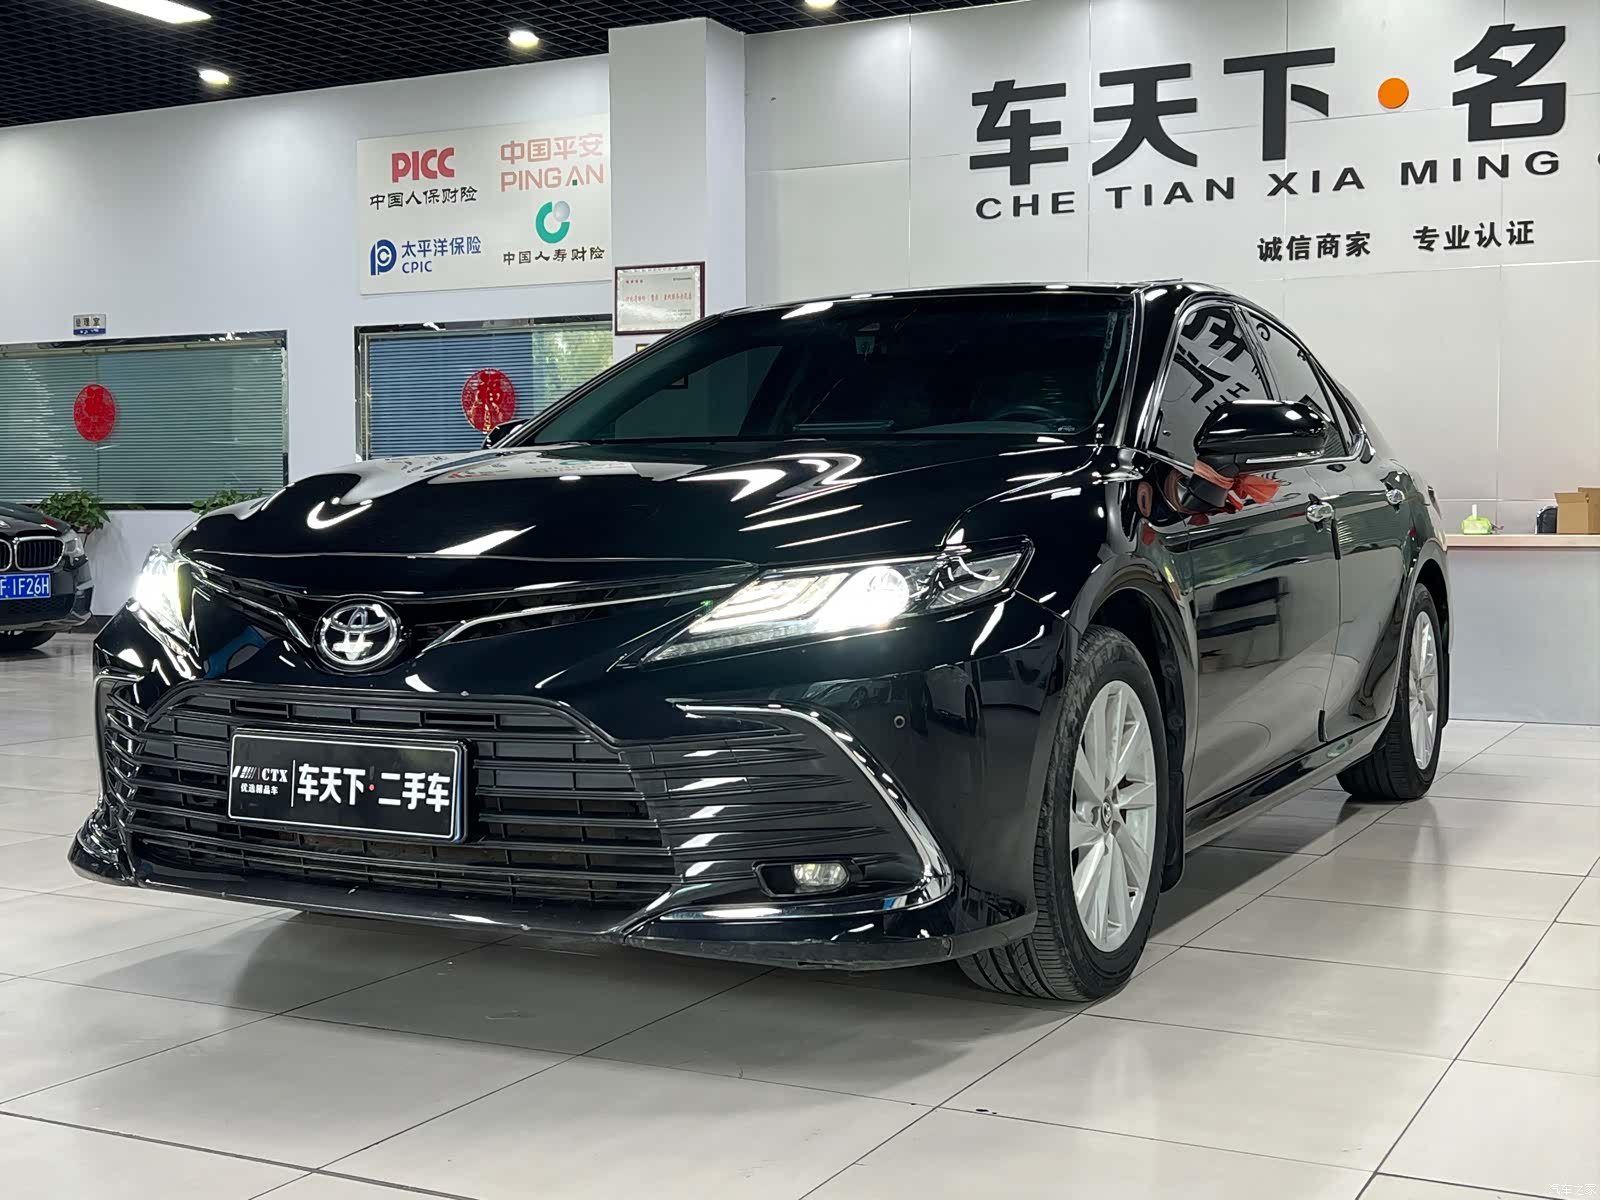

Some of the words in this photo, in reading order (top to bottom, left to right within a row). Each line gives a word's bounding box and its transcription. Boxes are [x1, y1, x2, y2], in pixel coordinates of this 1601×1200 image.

[500, 133, 604, 164] 中国平安
[392, 147, 455, 183] PICC
[975, 191, 1076, 220] CHE
[1104, 176, 1236, 209] TIAN
[1267, 167, 1365, 197] XIA
[1400, 150, 1560, 186] MING
[370, 186, 478, 210] 中国人保财险
[401, 236, 482, 258] 太平洋保险
[1256, 230, 1371, 262] 诚信商家
[1412, 220, 1535, 252] 专业认证
[503, 246, 605, 265] 中国人寿财险
[402, 261, 433, 274] CPIC
[261, 767, 288, 783] CTX
[240, 782, 279, 796] 优选精品车
